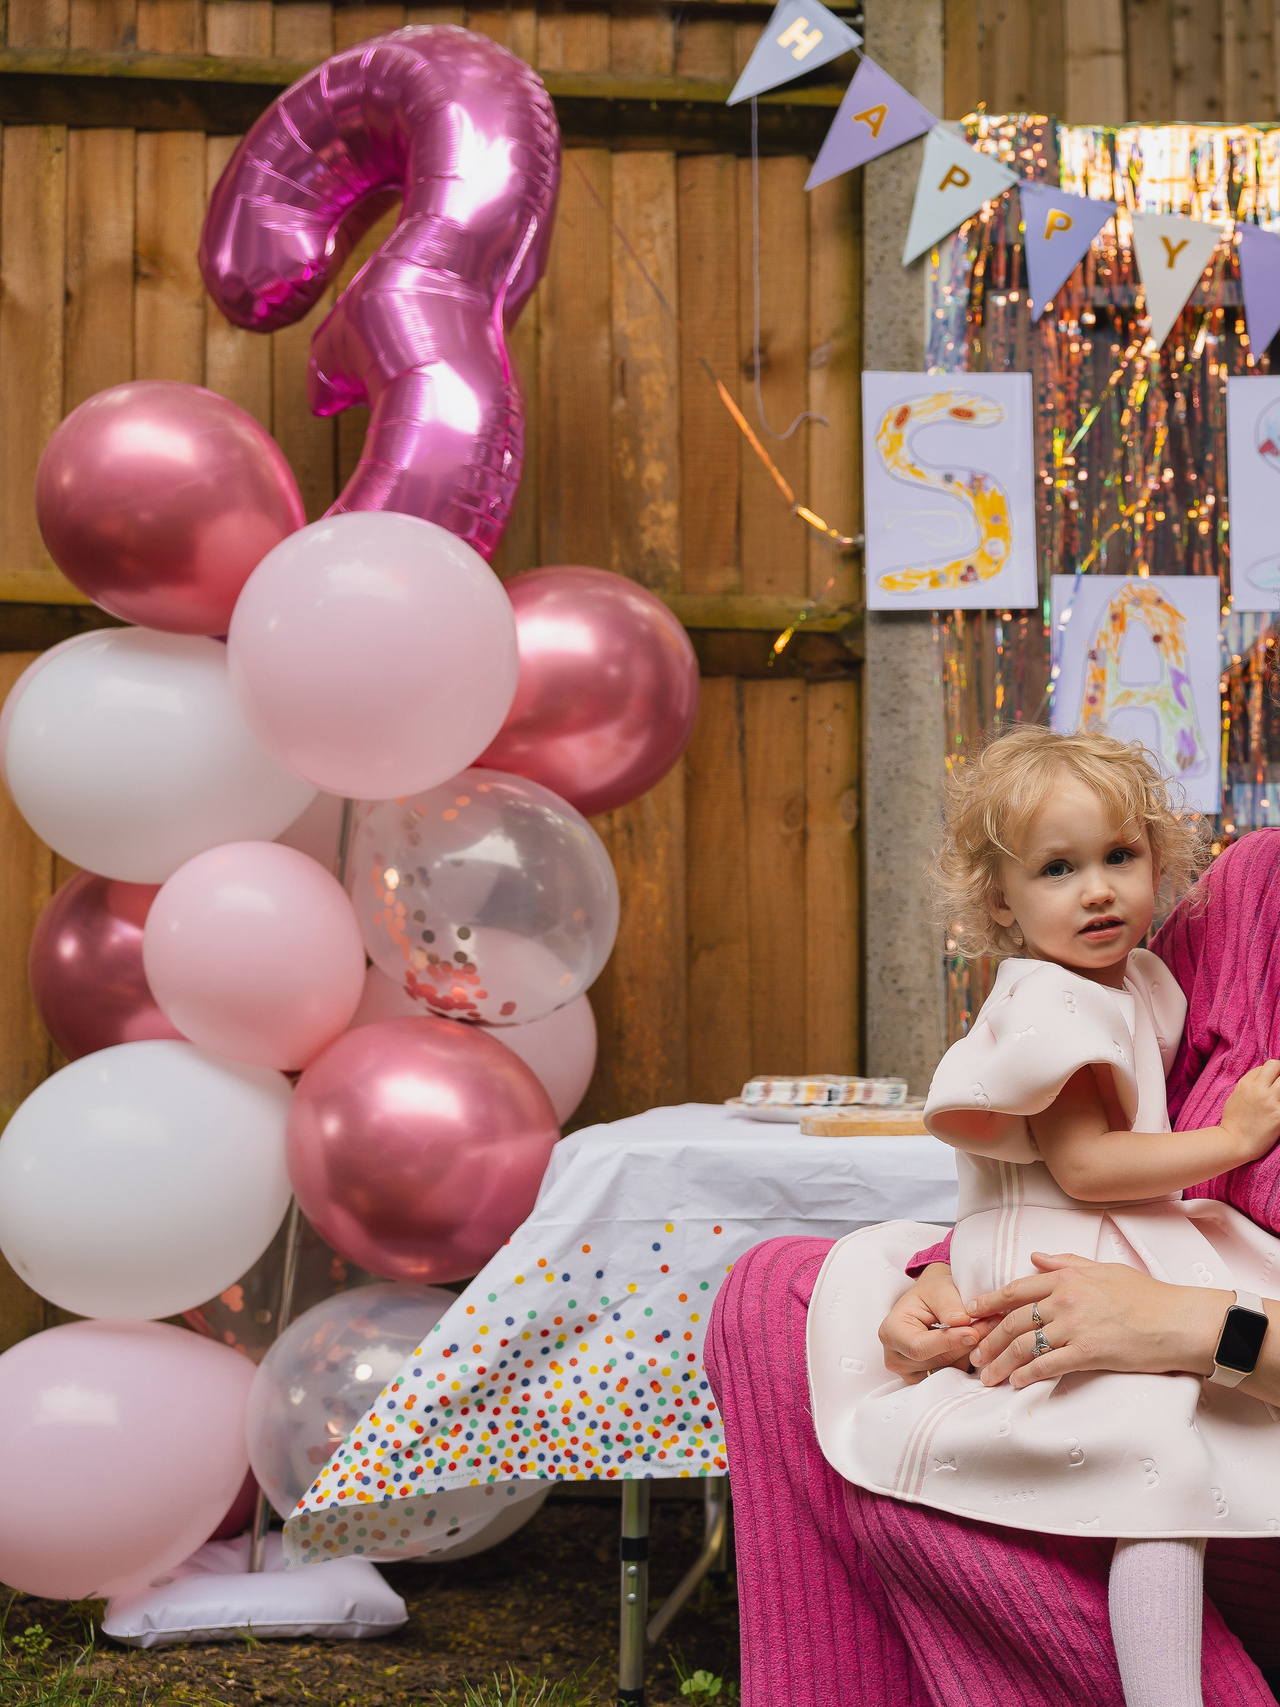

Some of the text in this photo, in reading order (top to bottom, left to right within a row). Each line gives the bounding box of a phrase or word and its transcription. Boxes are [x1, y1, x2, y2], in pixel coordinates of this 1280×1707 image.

[776, 16, 1190, 270] HAPPY
[968, 1082, 991, 1109] B
[1190, 1260, 1215, 1285] B
[839, 1354, 867, 1375] B
[995, 1407, 1013, 1438] B
[1063, 1436, 1086, 1468] B
[1138, 1456, 1161, 1490] B
[994, 1490, 1037, 1505] BAKER
[1210, 1486, 1230, 1518] B
